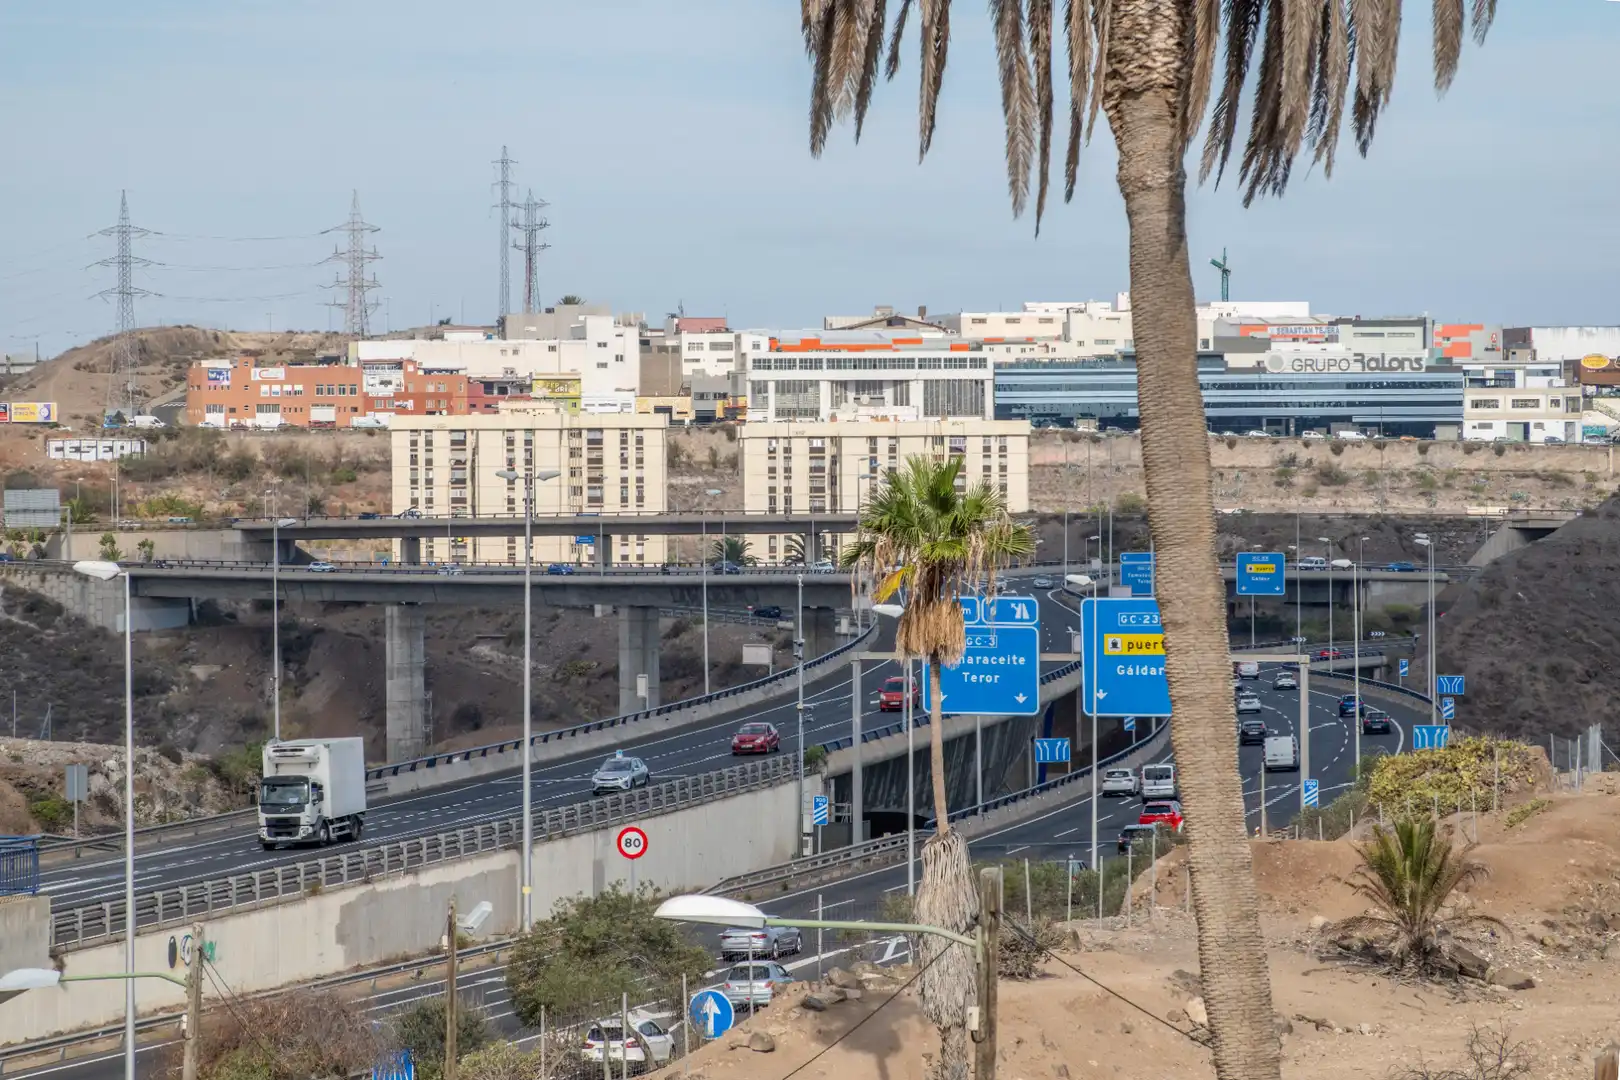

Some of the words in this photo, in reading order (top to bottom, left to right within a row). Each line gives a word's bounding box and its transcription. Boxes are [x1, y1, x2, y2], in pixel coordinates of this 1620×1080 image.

[1291, 358, 1350, 372] GRUPO
[1116, 664, 1165, 676] Gáldar
[962, 672, 1000, 683] Teror
[624, 838, 642, 848] 80
